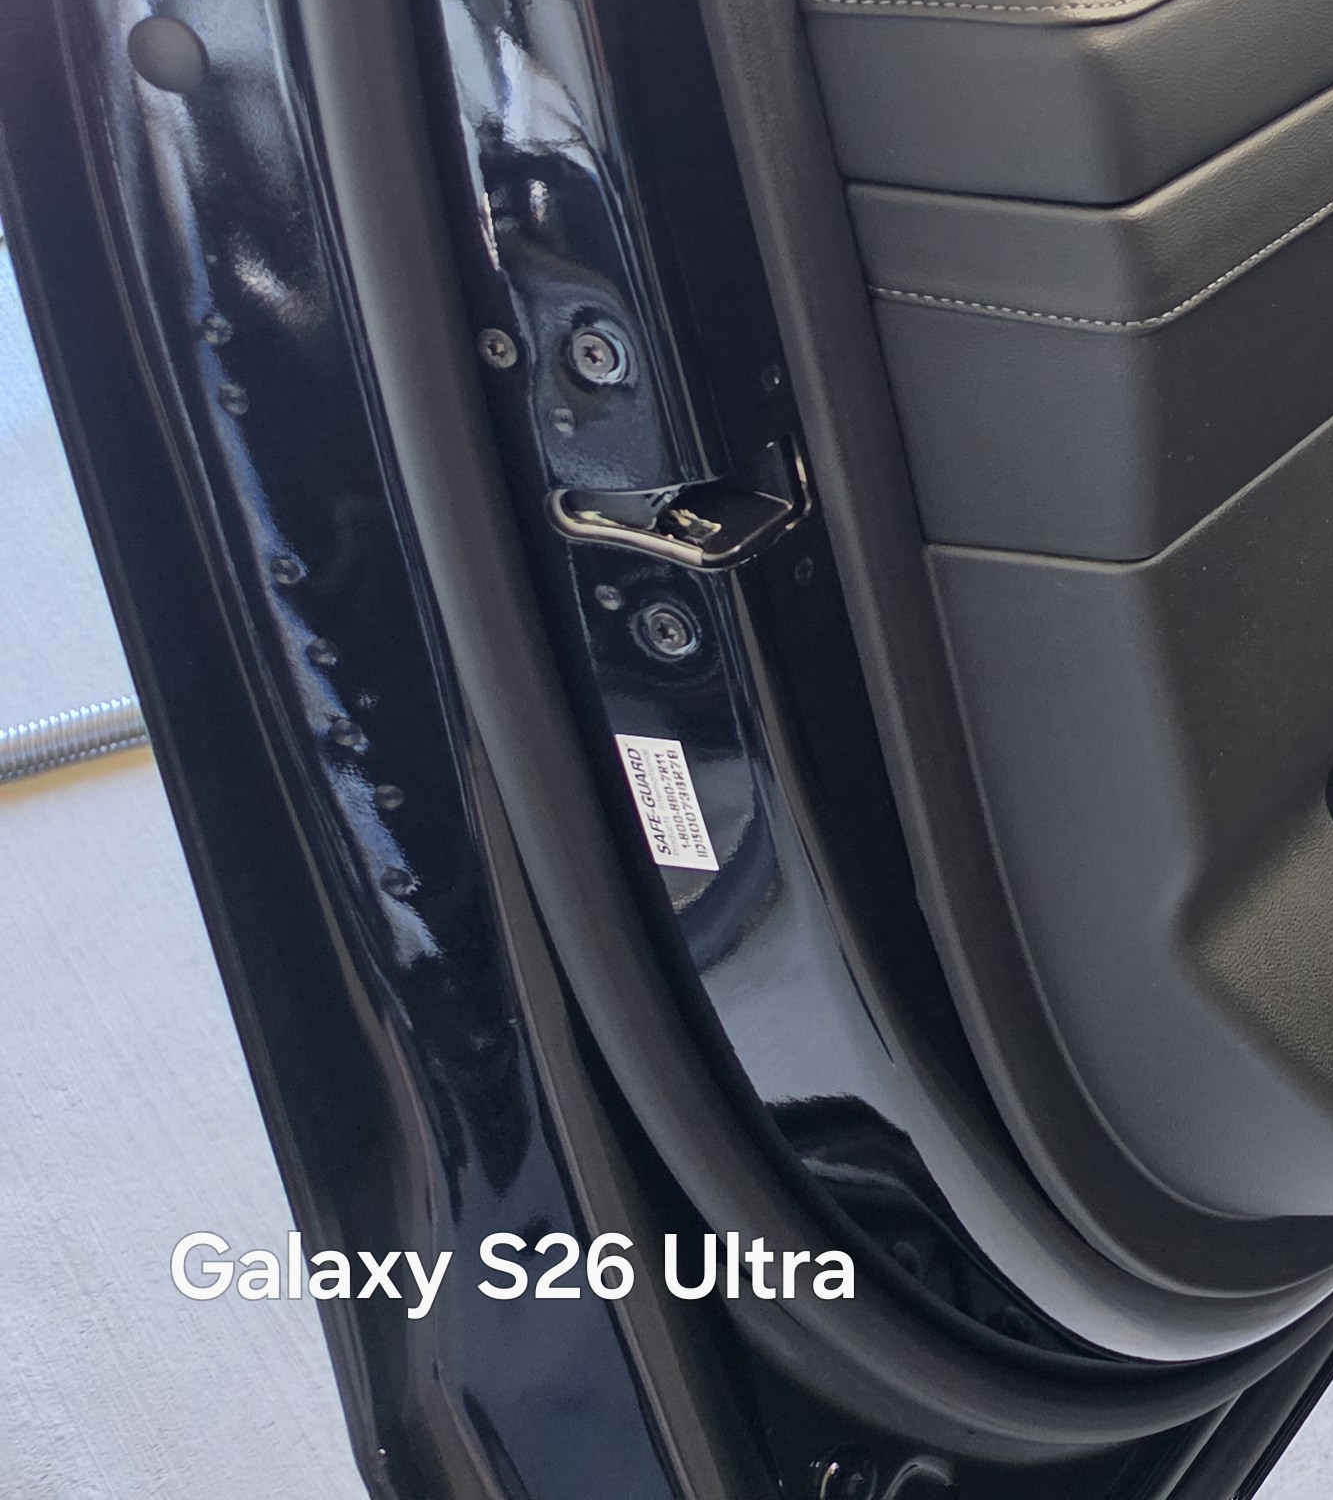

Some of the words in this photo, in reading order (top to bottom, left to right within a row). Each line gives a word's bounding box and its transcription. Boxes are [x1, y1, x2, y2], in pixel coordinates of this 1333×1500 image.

[625, 747, 671, 855] SAFE-GUARD
[640, 748, 667, 810] International
[661, 815, 681, 855] Products
